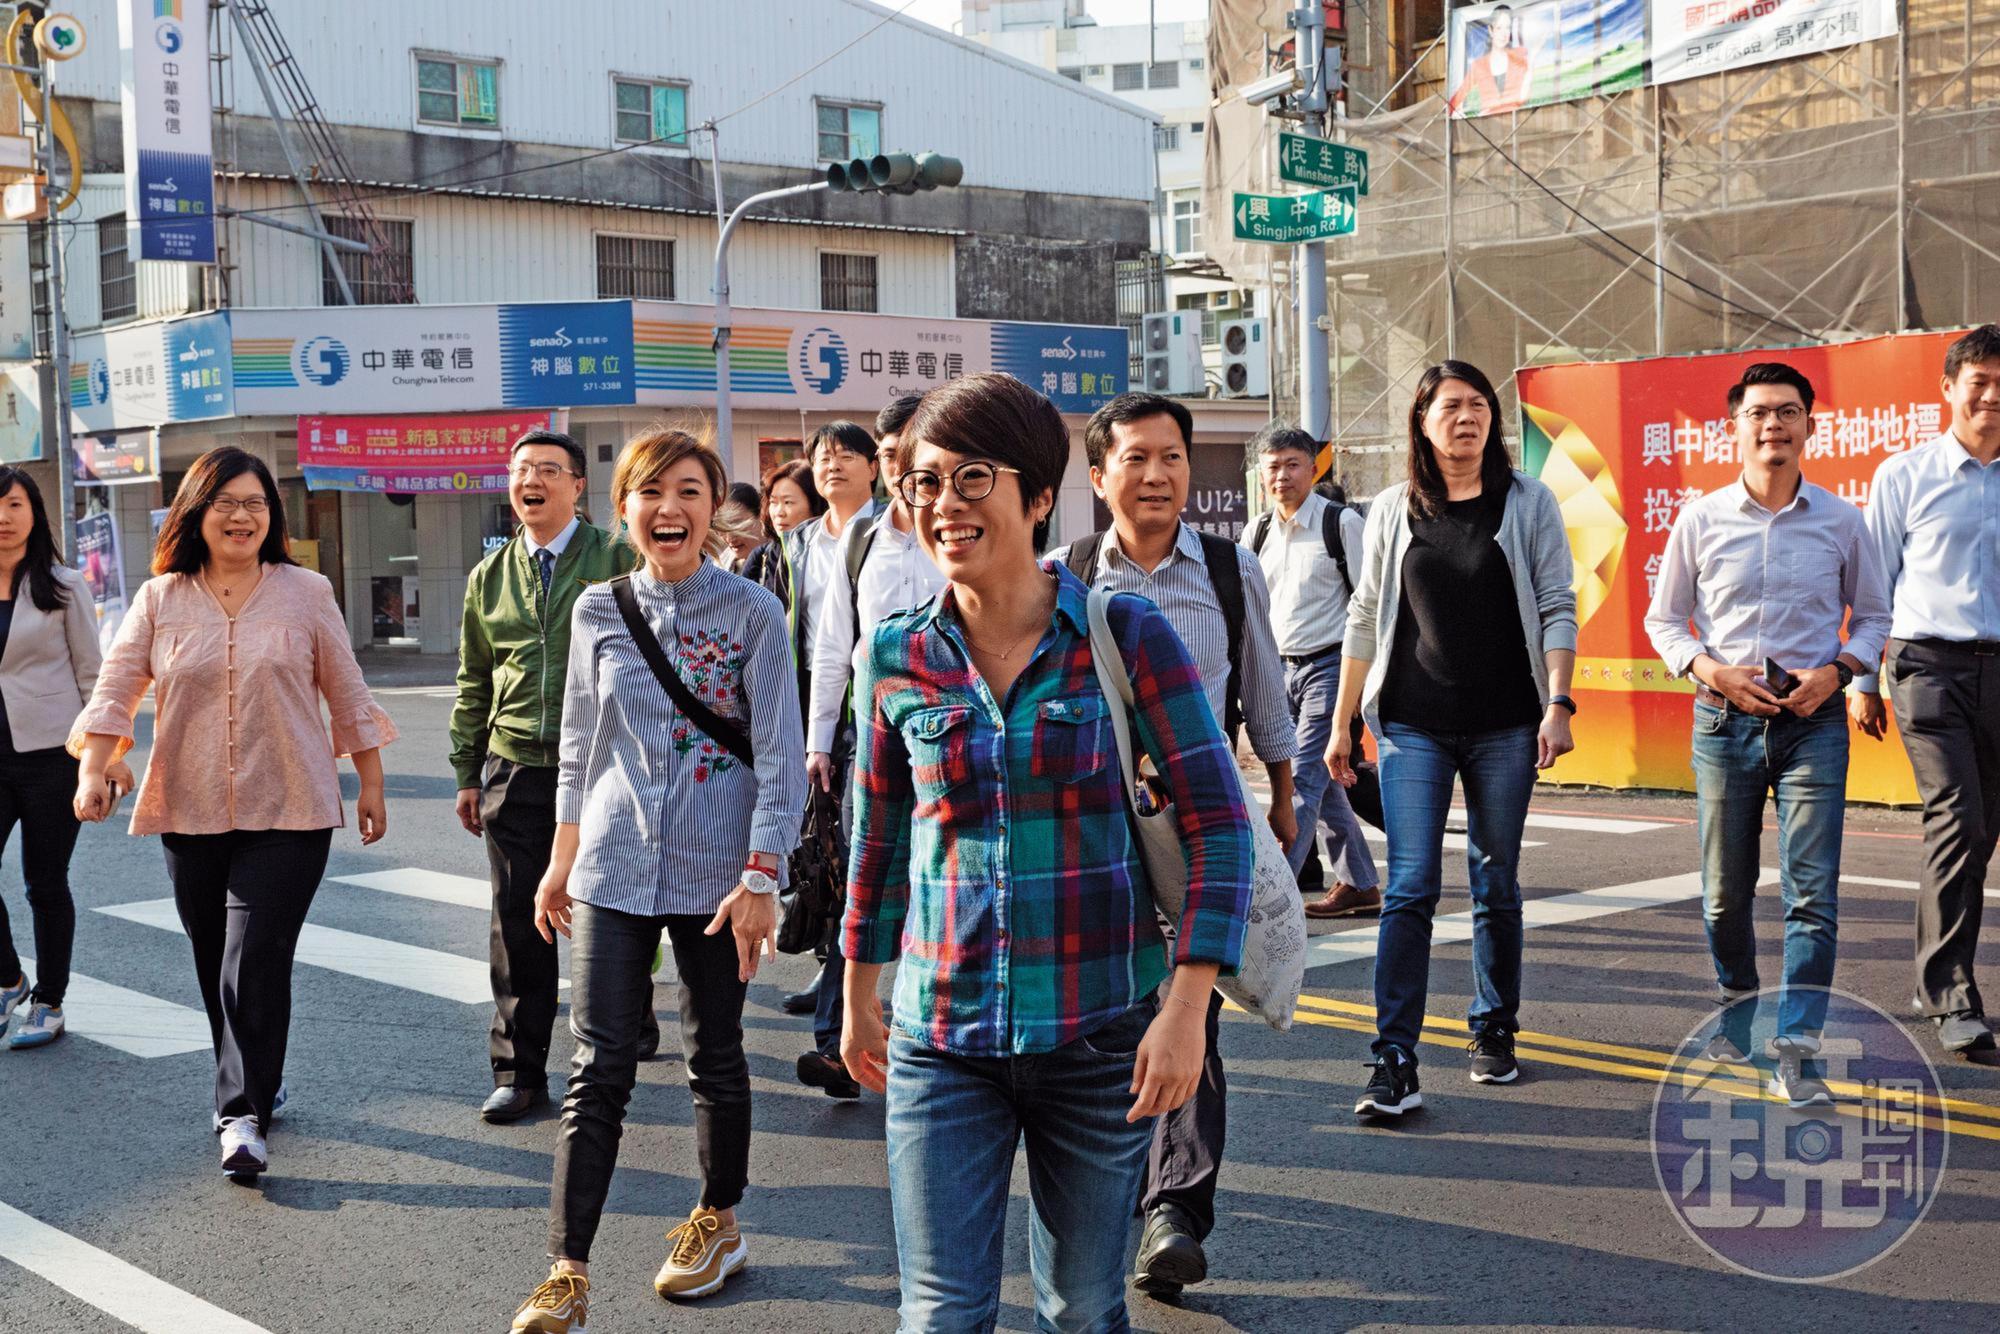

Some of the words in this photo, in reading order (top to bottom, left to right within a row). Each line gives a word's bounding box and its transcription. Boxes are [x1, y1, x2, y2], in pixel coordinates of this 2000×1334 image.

[1774, 11, 1860, 49] 高貴不貴
[162, 62, 181, 134] 中華電信
[1290, 136, 1360, 176] 民生路
[1294, 164, 1339, 184] Minsheng
[148, 197, 205, 215] 神腦數位
[1248, 191, 1344, 222] 興中路
[1253, 222, 1317, 241] Singjhong
[1320, 218, 1339, 233] Rd.
[362, 347, 474, 371] 中華電信
[530, 355, 620, 376] 神腦數位
[860, 349, 964, 380] 中華電信
[114, 365, 154, 387] 中華電信
[392, 376, 438, 387] Chunghwa
[439, 375, 474, 384] Telecom
[583, 381, 622, 391] 571-3388
[1041, 371, 1116, 395] 神腦數位
[1642, 402, 1942, 467] 興中路領袖地標
